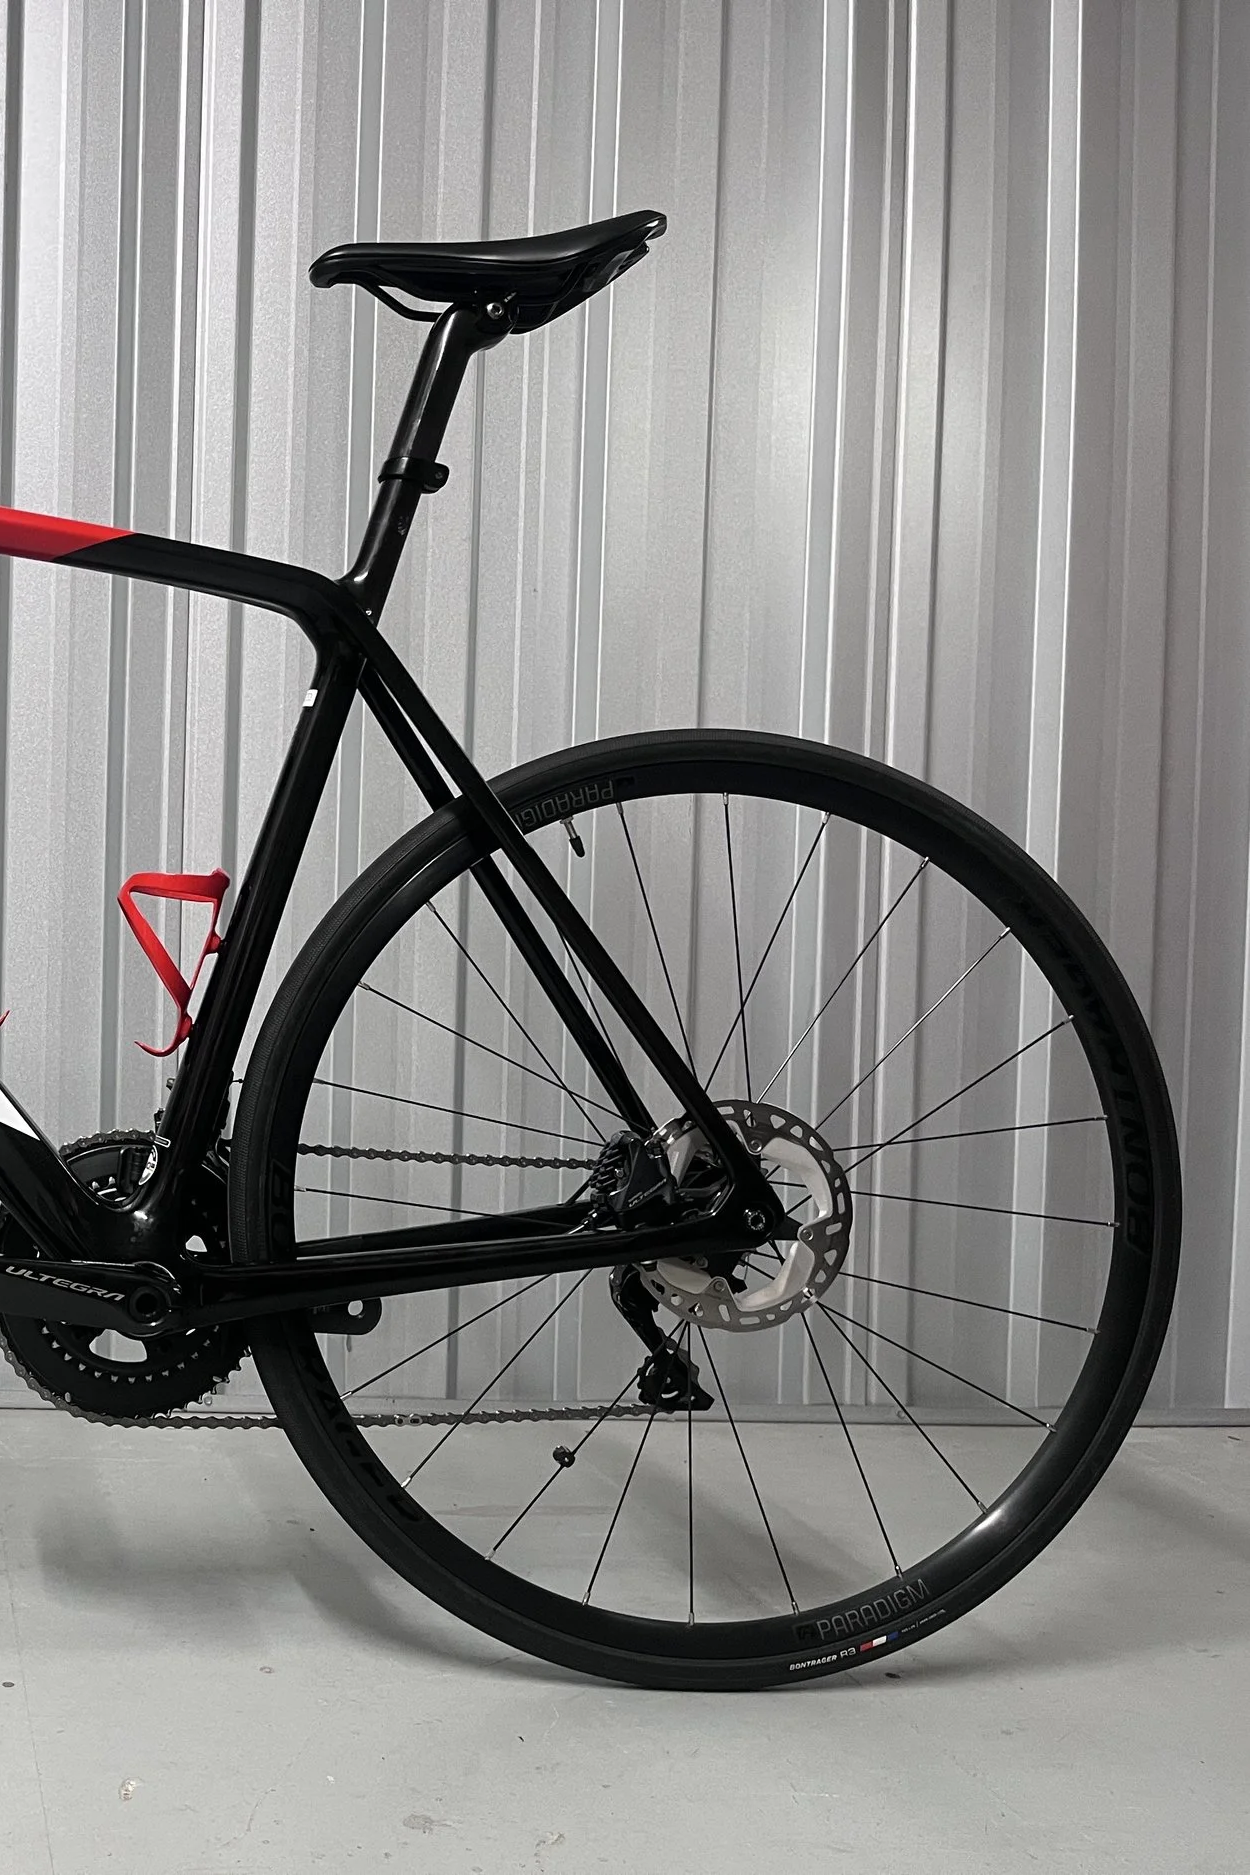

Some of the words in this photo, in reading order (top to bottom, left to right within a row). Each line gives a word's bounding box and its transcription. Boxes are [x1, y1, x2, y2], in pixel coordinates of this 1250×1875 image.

[514, 779, 614, 829] PARADIG
[5, 1265, 126, 1301] ULTEGRA
[816, 1578, 931, 1640] PARADIGM
[789, 1654, 838, 1671] BONTRAGER
[839, 1647, 857, 1659] R3
